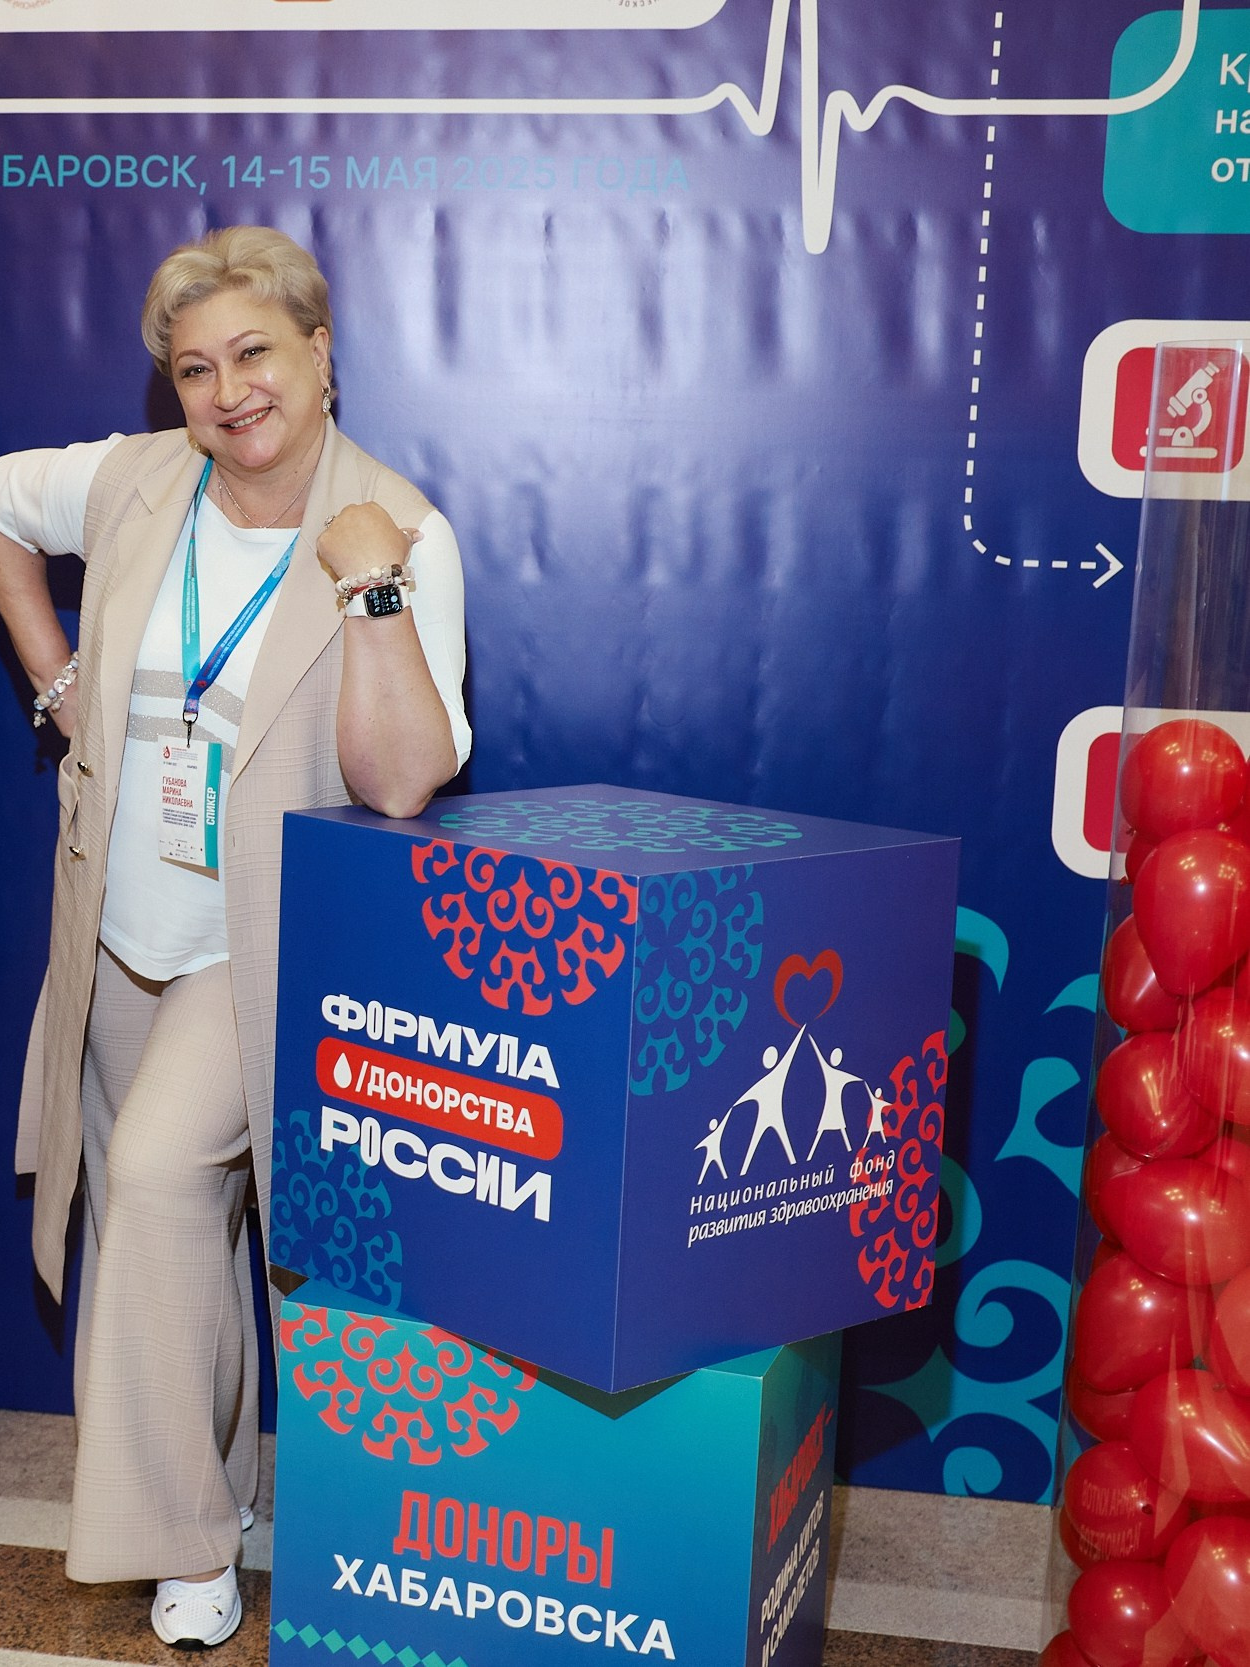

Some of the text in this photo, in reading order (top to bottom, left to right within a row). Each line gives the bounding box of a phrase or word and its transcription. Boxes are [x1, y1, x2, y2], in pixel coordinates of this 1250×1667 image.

[1220, 53, 1250, 94] К
[222, 155, 332, 190] 14-15
[345, 156, 438, 190] МАЯ
[453, 156, 557, 191] 2025
[572, 158, 690, 198] ГОДА
[162, 786, 182, 797] МАРИНА
[206, 786, 217, 826] СПИКЕР
[321, 993, 560, 1089] ФОРМУЛА
[320, 1105, 552, 1222] РОССИИ
[690, 1150, 896, 1216] Национальный фонд
[688, 1178, 894, 1248] развития здравоохранения
[393, 1489, 615, 1589] ДОНОРЫ
[760, 1490, 824, 1635] РОДИНА КИТОВ
[332, 1553, 676, 1661] ХАБАРОВСКА
[770, 1537, 821, 1658] САМОЛЕТОВ
